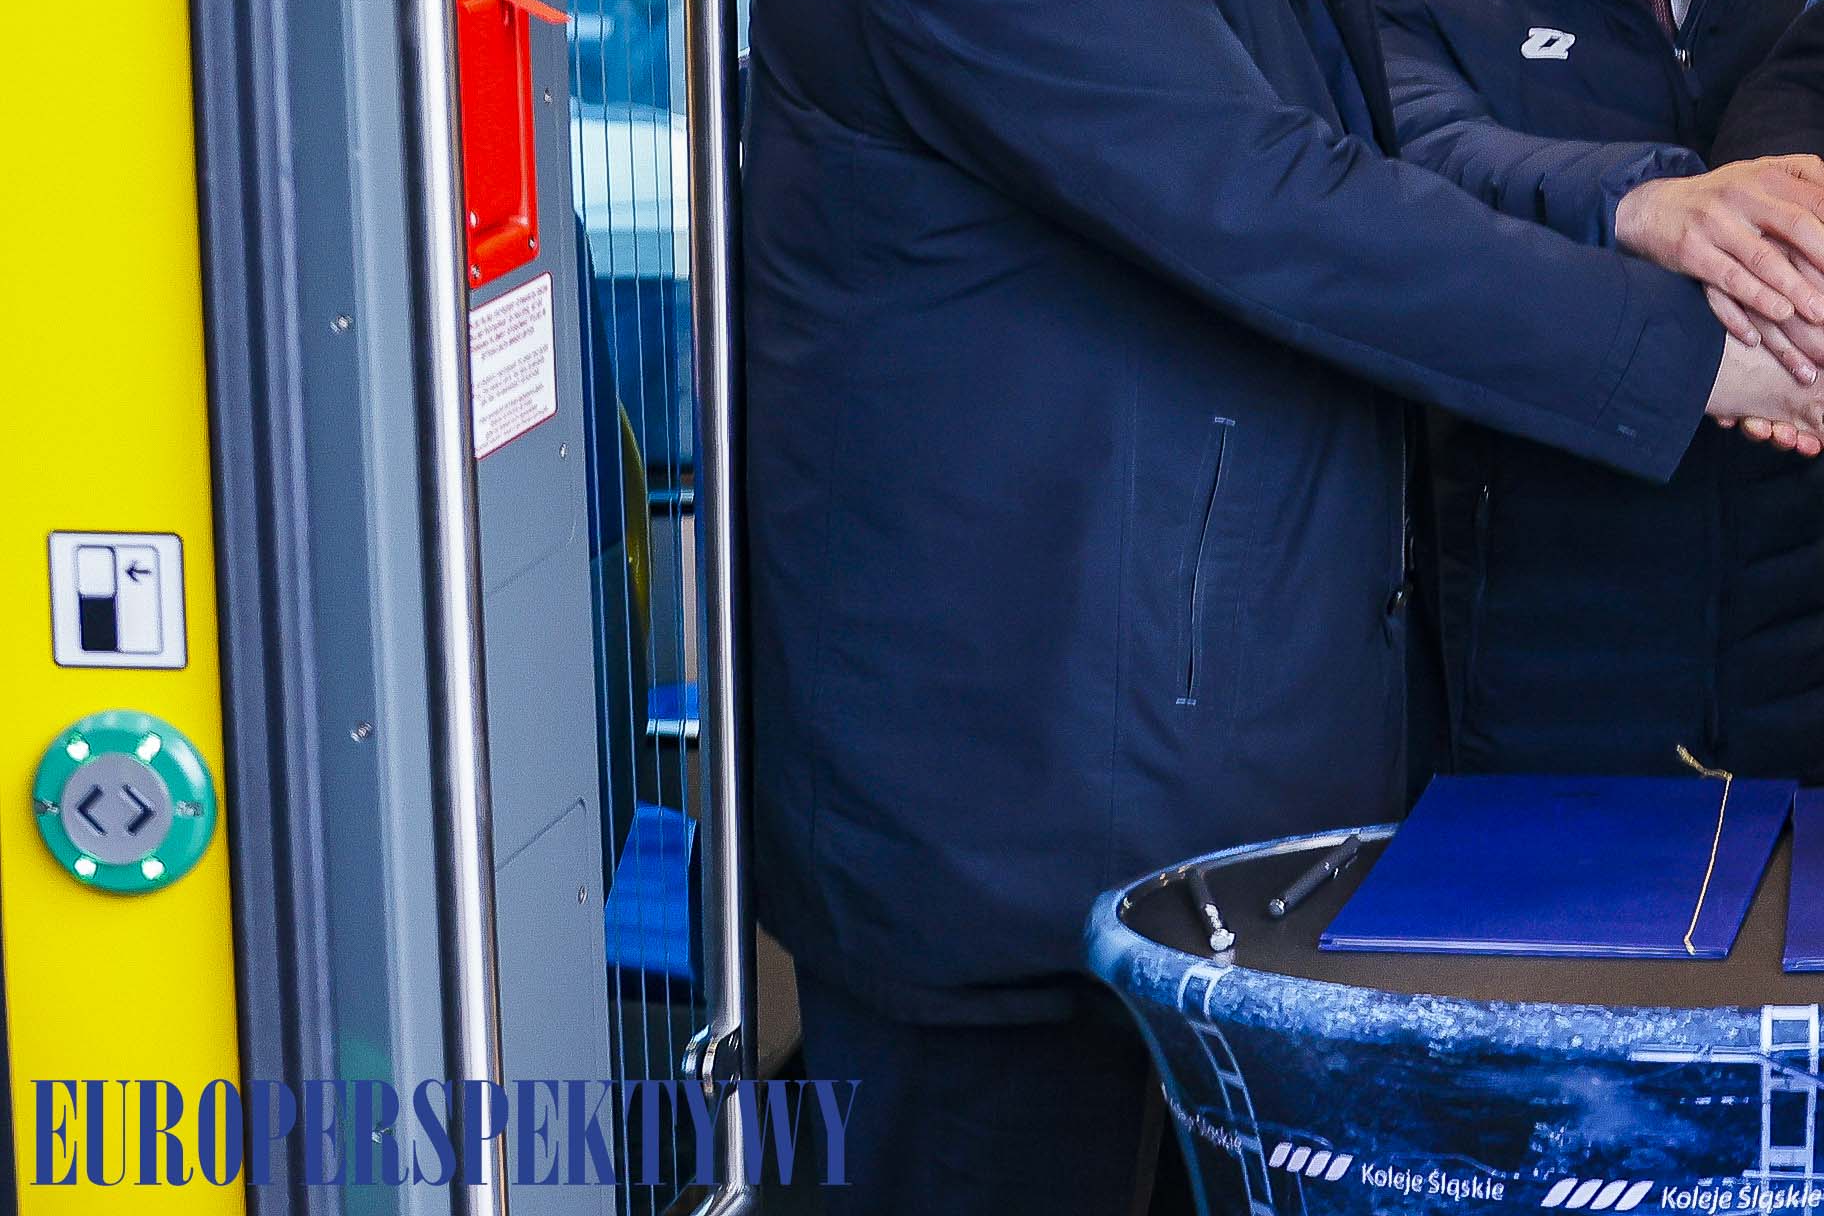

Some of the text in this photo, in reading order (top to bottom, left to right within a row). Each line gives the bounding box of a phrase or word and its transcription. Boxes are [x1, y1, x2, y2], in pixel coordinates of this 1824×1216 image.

[1361, 1162, 1505, 1202] Koleje Śląskie
[1660, 1184, 1823, 1214] Koleje Śląskie
